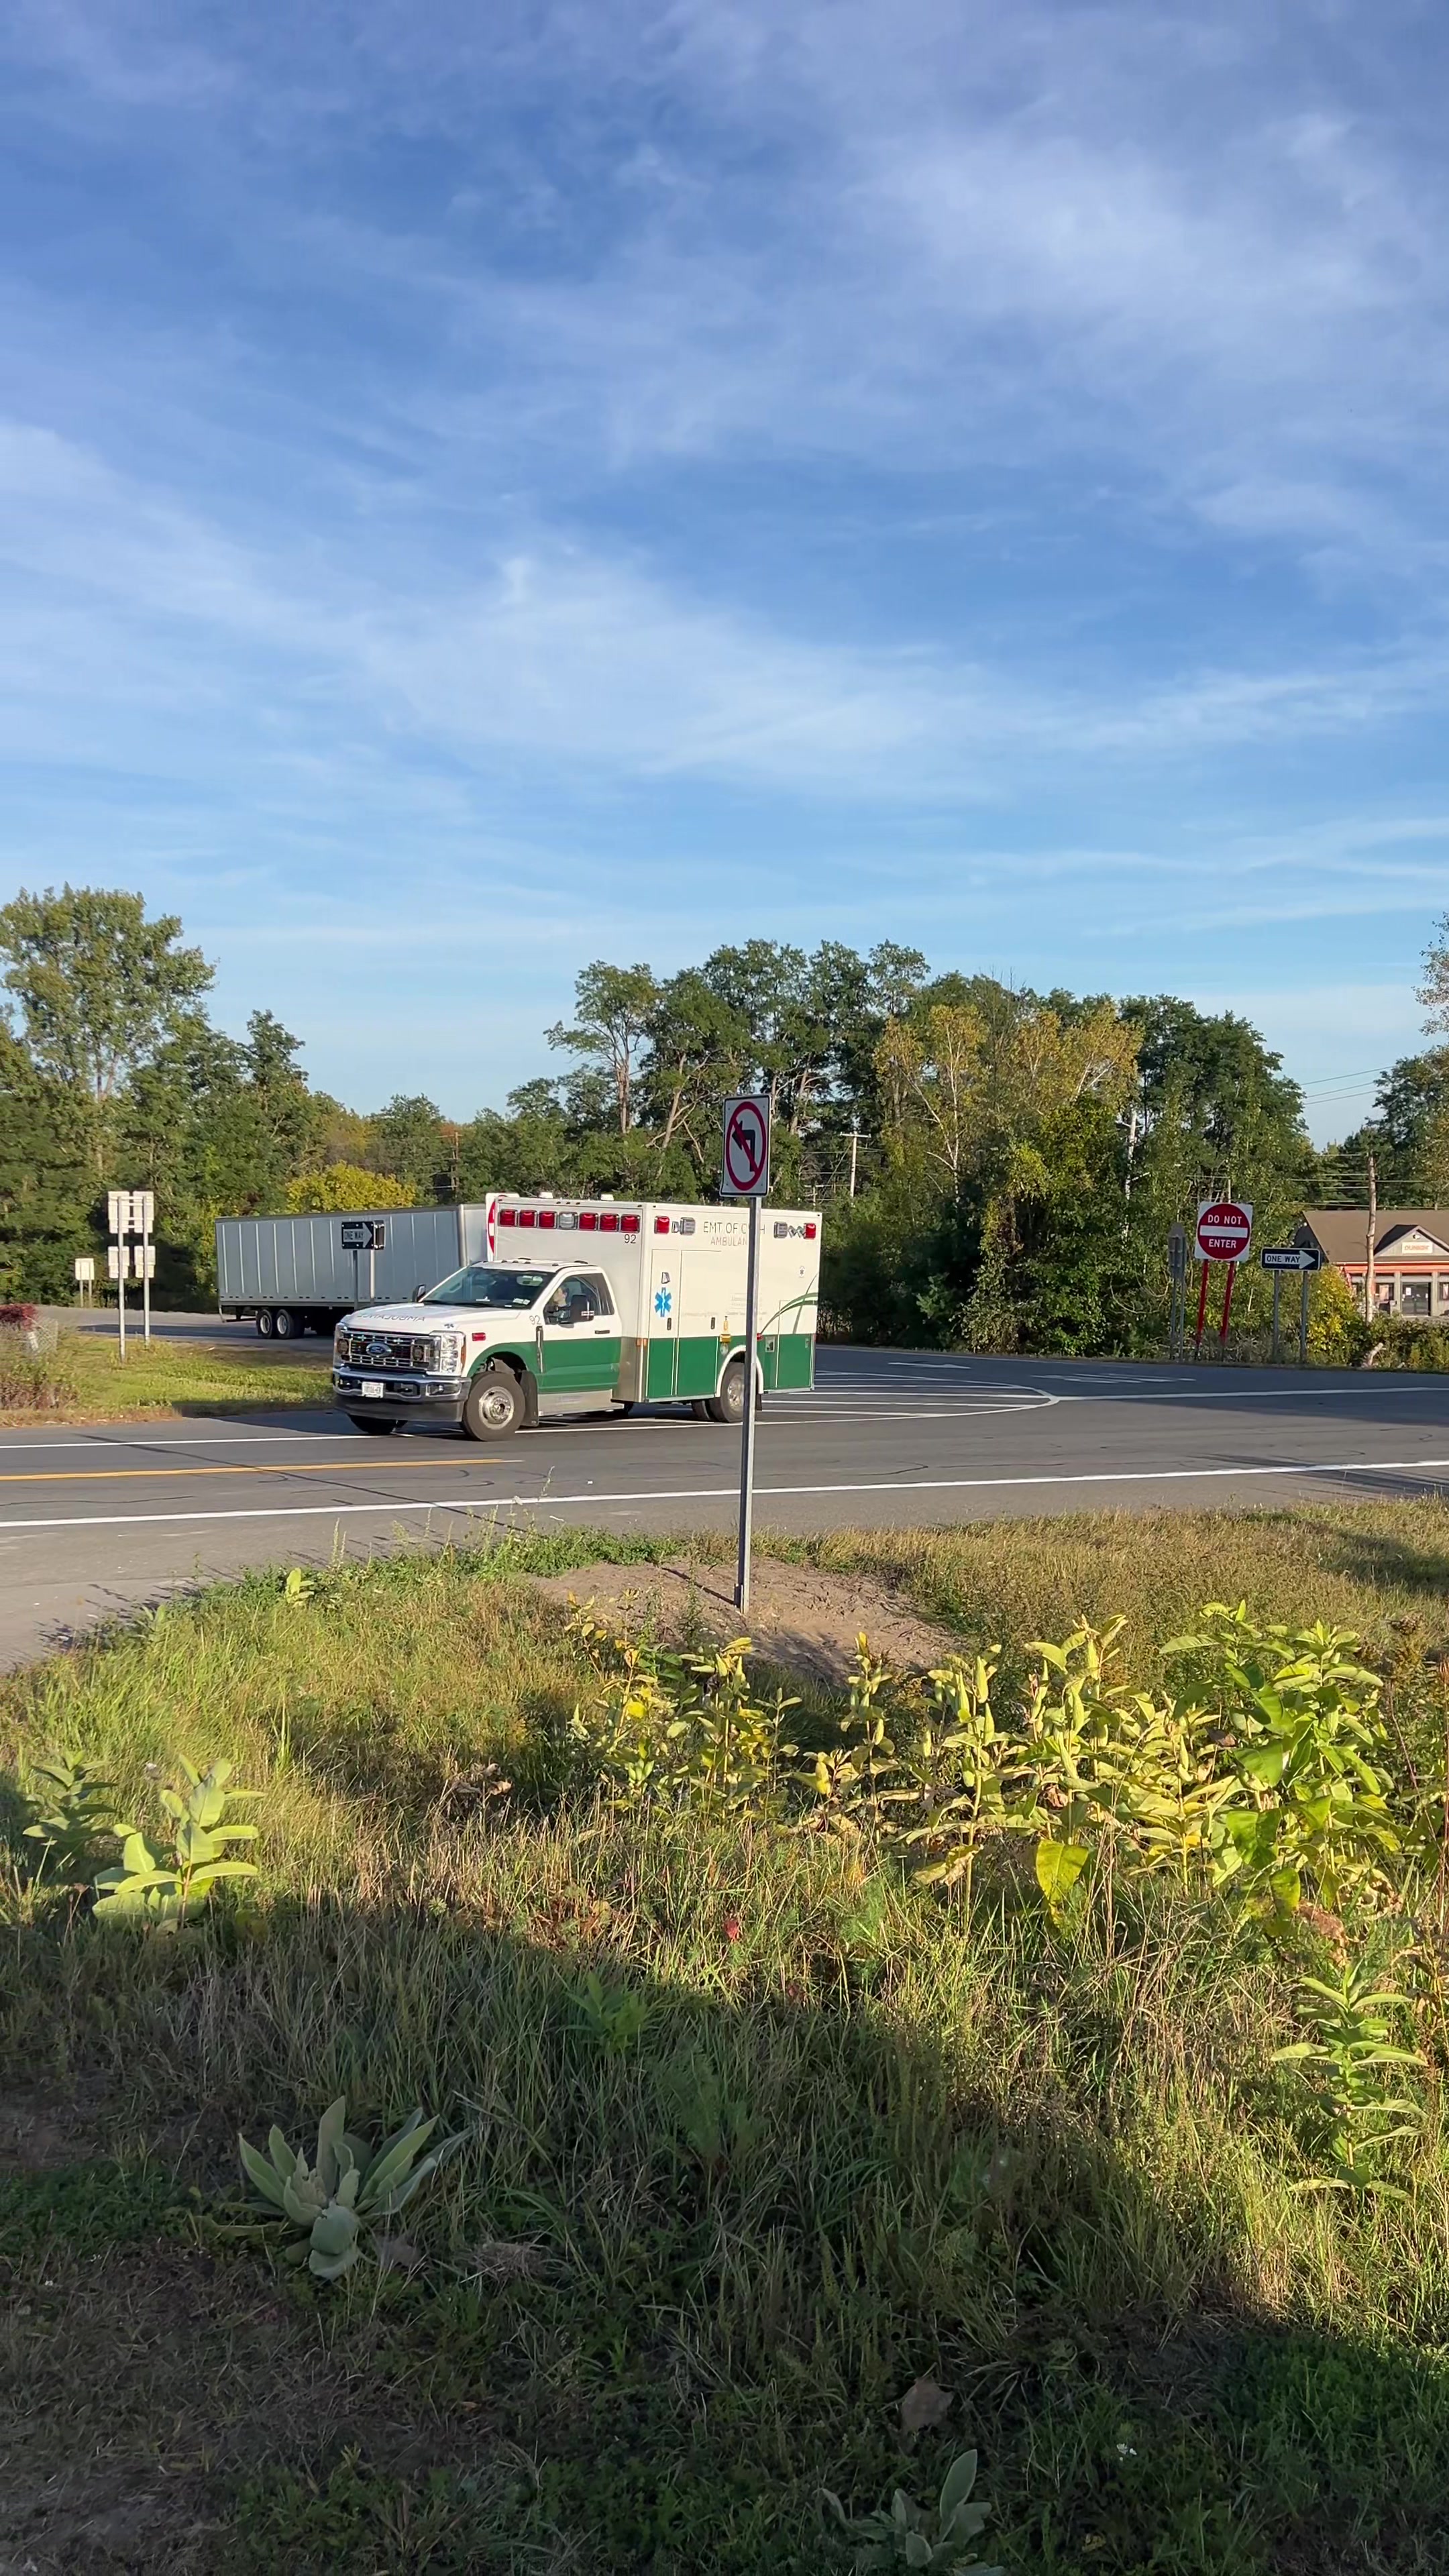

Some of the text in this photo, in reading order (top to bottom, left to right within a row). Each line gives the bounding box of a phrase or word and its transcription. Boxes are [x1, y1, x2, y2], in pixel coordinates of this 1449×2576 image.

[1208, 1214, 1242, 1225] DO NOT
[703, 1221, 722, 1233] EMT
[725, 1222, 738, 1234] OF
[624, 1234, 636, 1244] 92
[710, 1236, 748, 1246] AMBULAN
[1208, 1238, 1236, 1248] ENTER
[529, 1315, 541, 1325] 92
